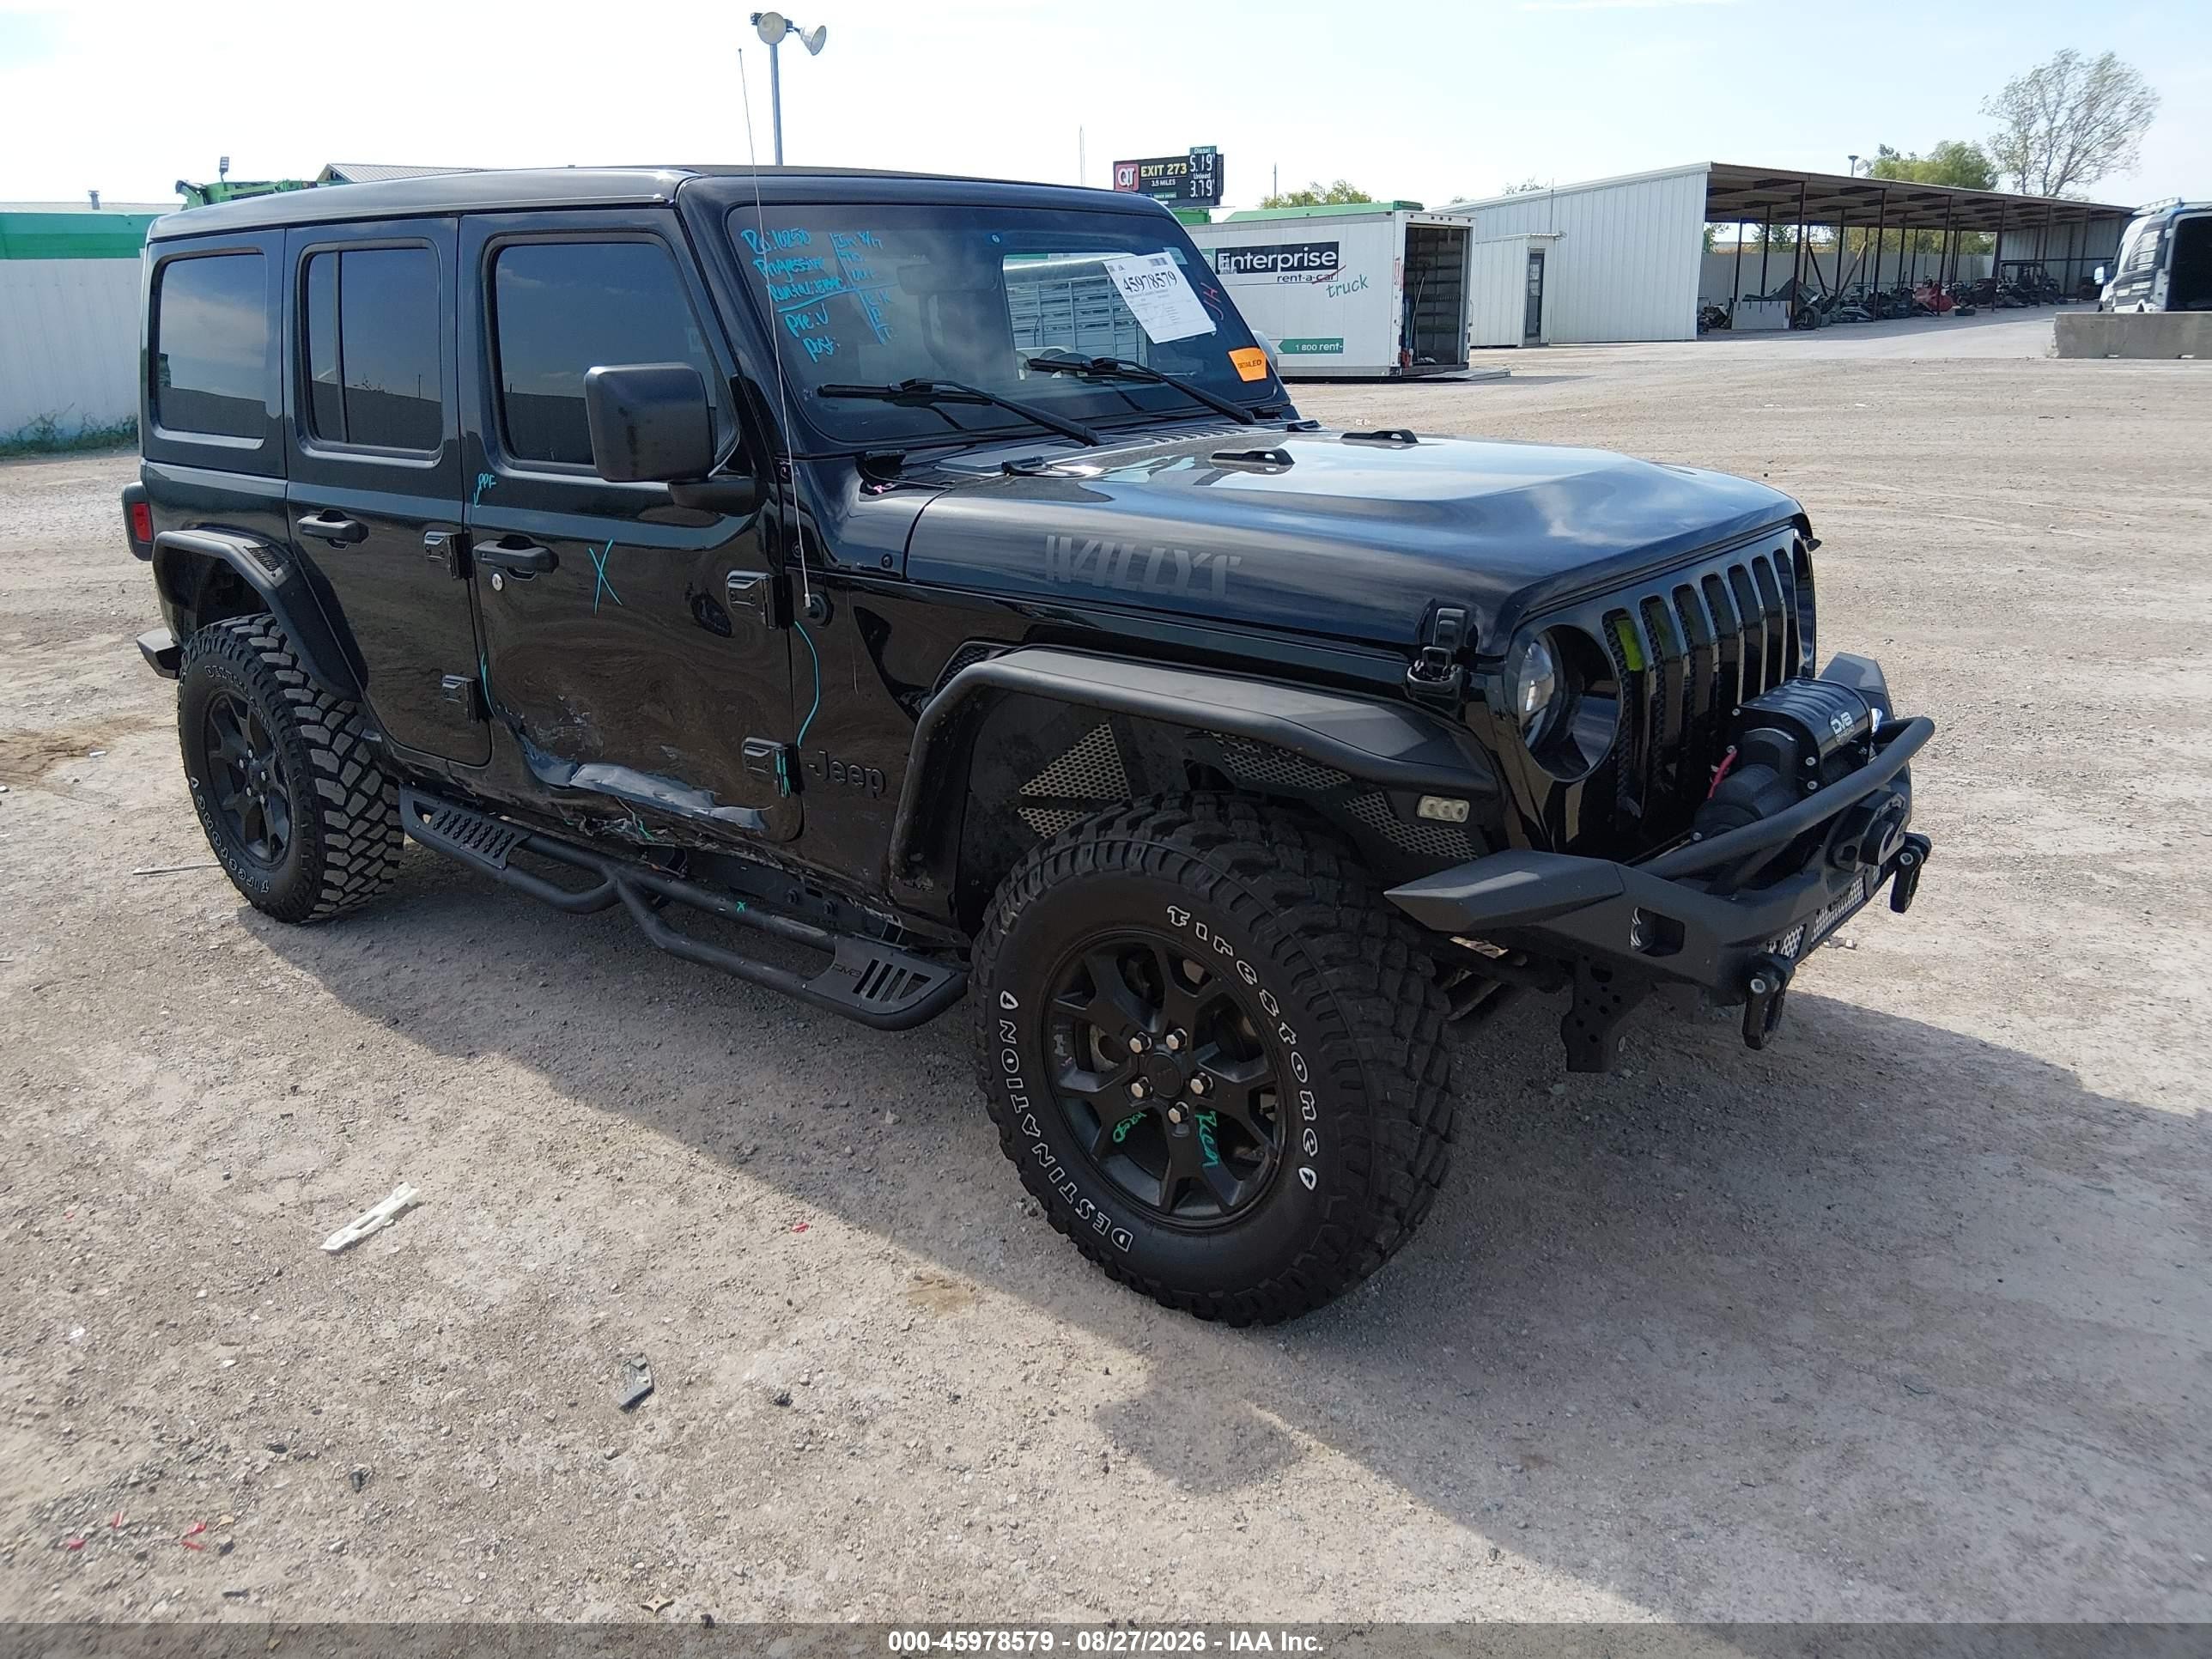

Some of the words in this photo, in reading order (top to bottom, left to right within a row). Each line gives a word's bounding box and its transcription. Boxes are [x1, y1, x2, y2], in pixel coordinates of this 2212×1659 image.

[1117, 167, 1135, 187] QT
[1140, 164, 1165, 177] EXIT
[1167, 162, 1188, 174] 273
[1218, 246, 1337, 273] Enterprise
[1123, 270, 1178, 293] 45978579
[1277, 272, 1336, 283] rent-a-car
[1326, 274, 1369, 298] truck
[807, 749, 886, 799] Jeep
[999, 1018, 1134, 1253] DESTINATION
